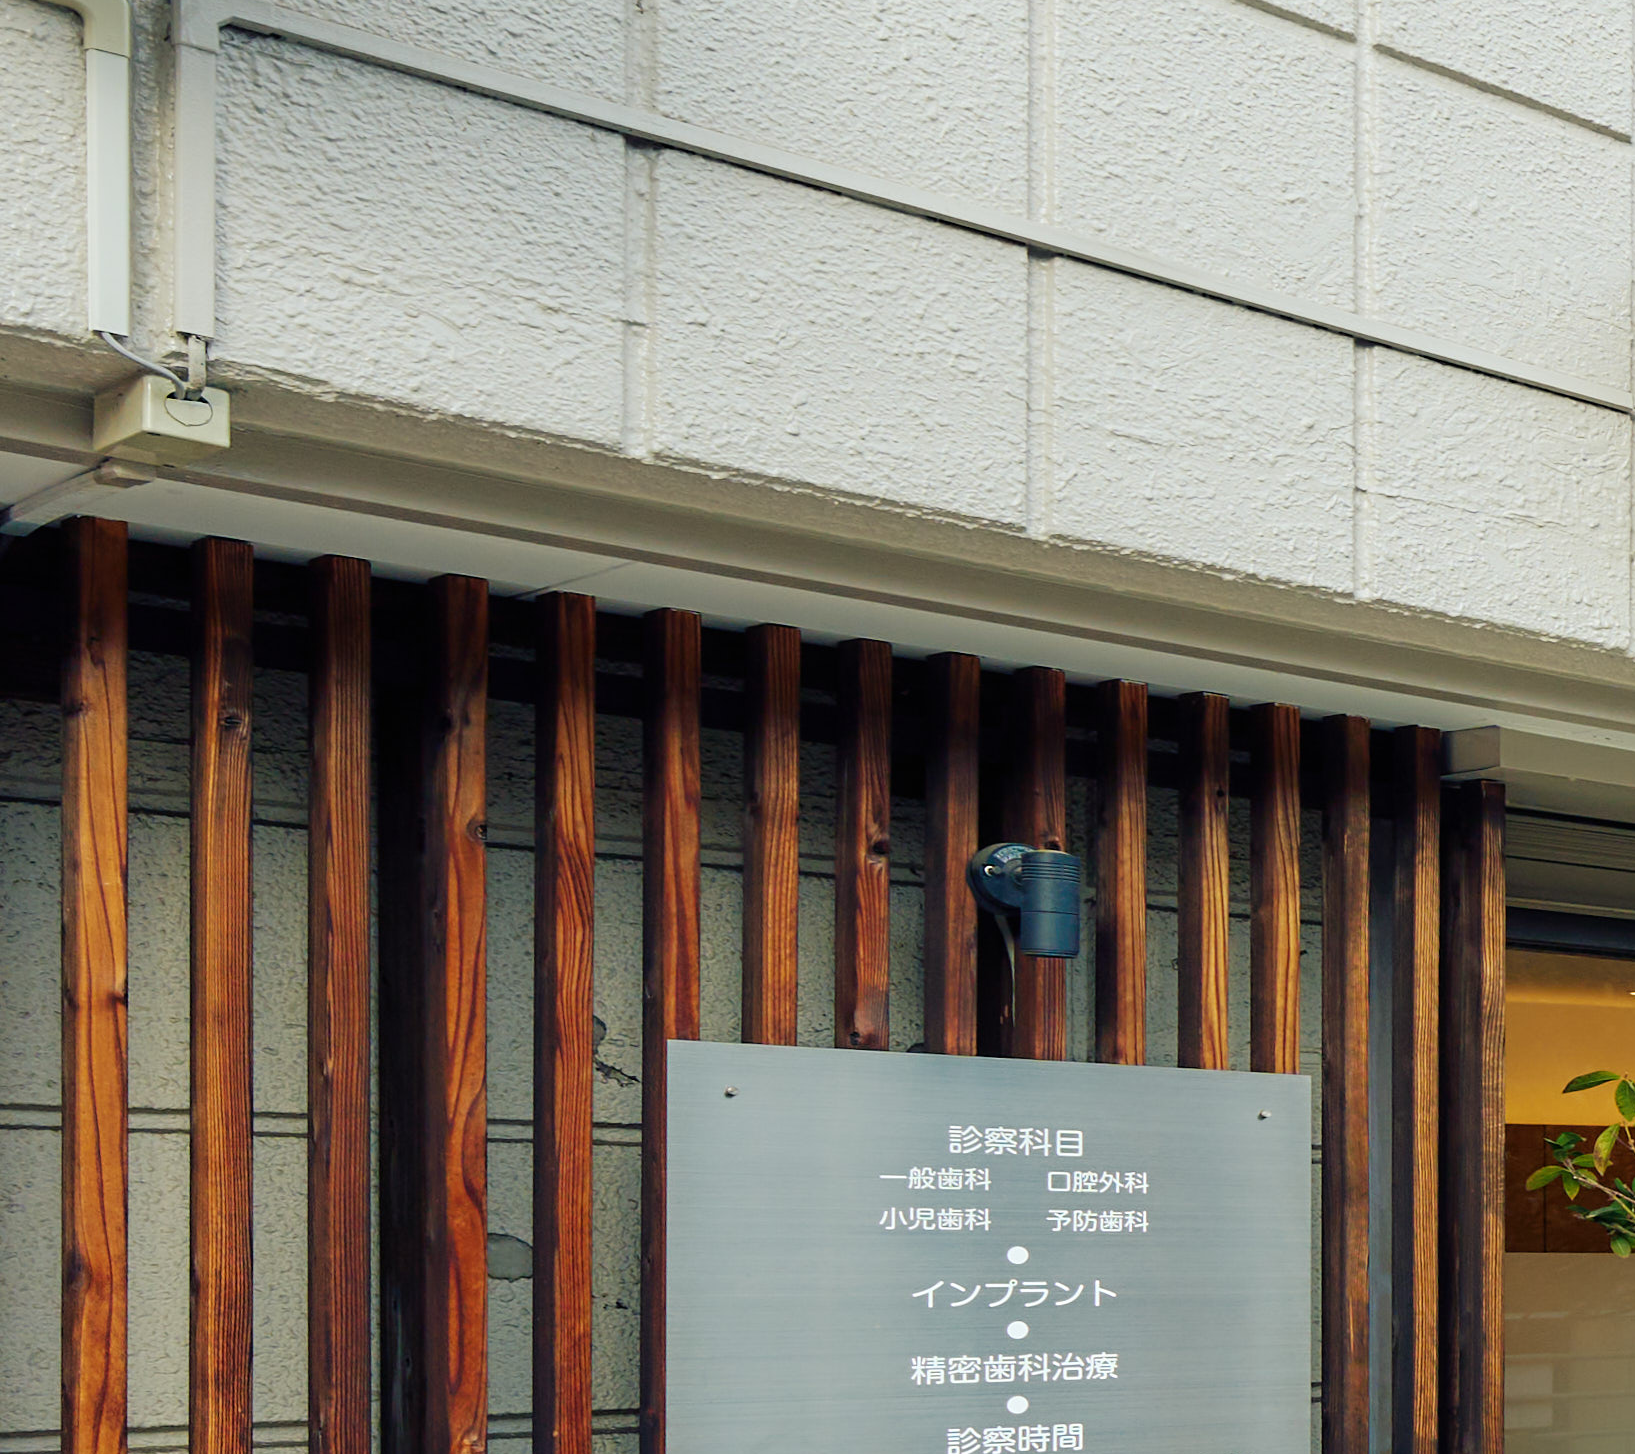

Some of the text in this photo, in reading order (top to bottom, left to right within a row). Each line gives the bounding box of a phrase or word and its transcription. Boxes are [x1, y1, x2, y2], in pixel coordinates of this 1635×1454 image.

[948, 1124, 1084, 1157] 診察科目
[879, 1166, 1150, 1195] 一般歯科 口腔外科
[879, 1206, 1150, 1233] 小児歯科 予防歯科
[911, 1278, 1118, 1308] インプラント
[911, 1351, 1119, 1386] 精密歯科治療
